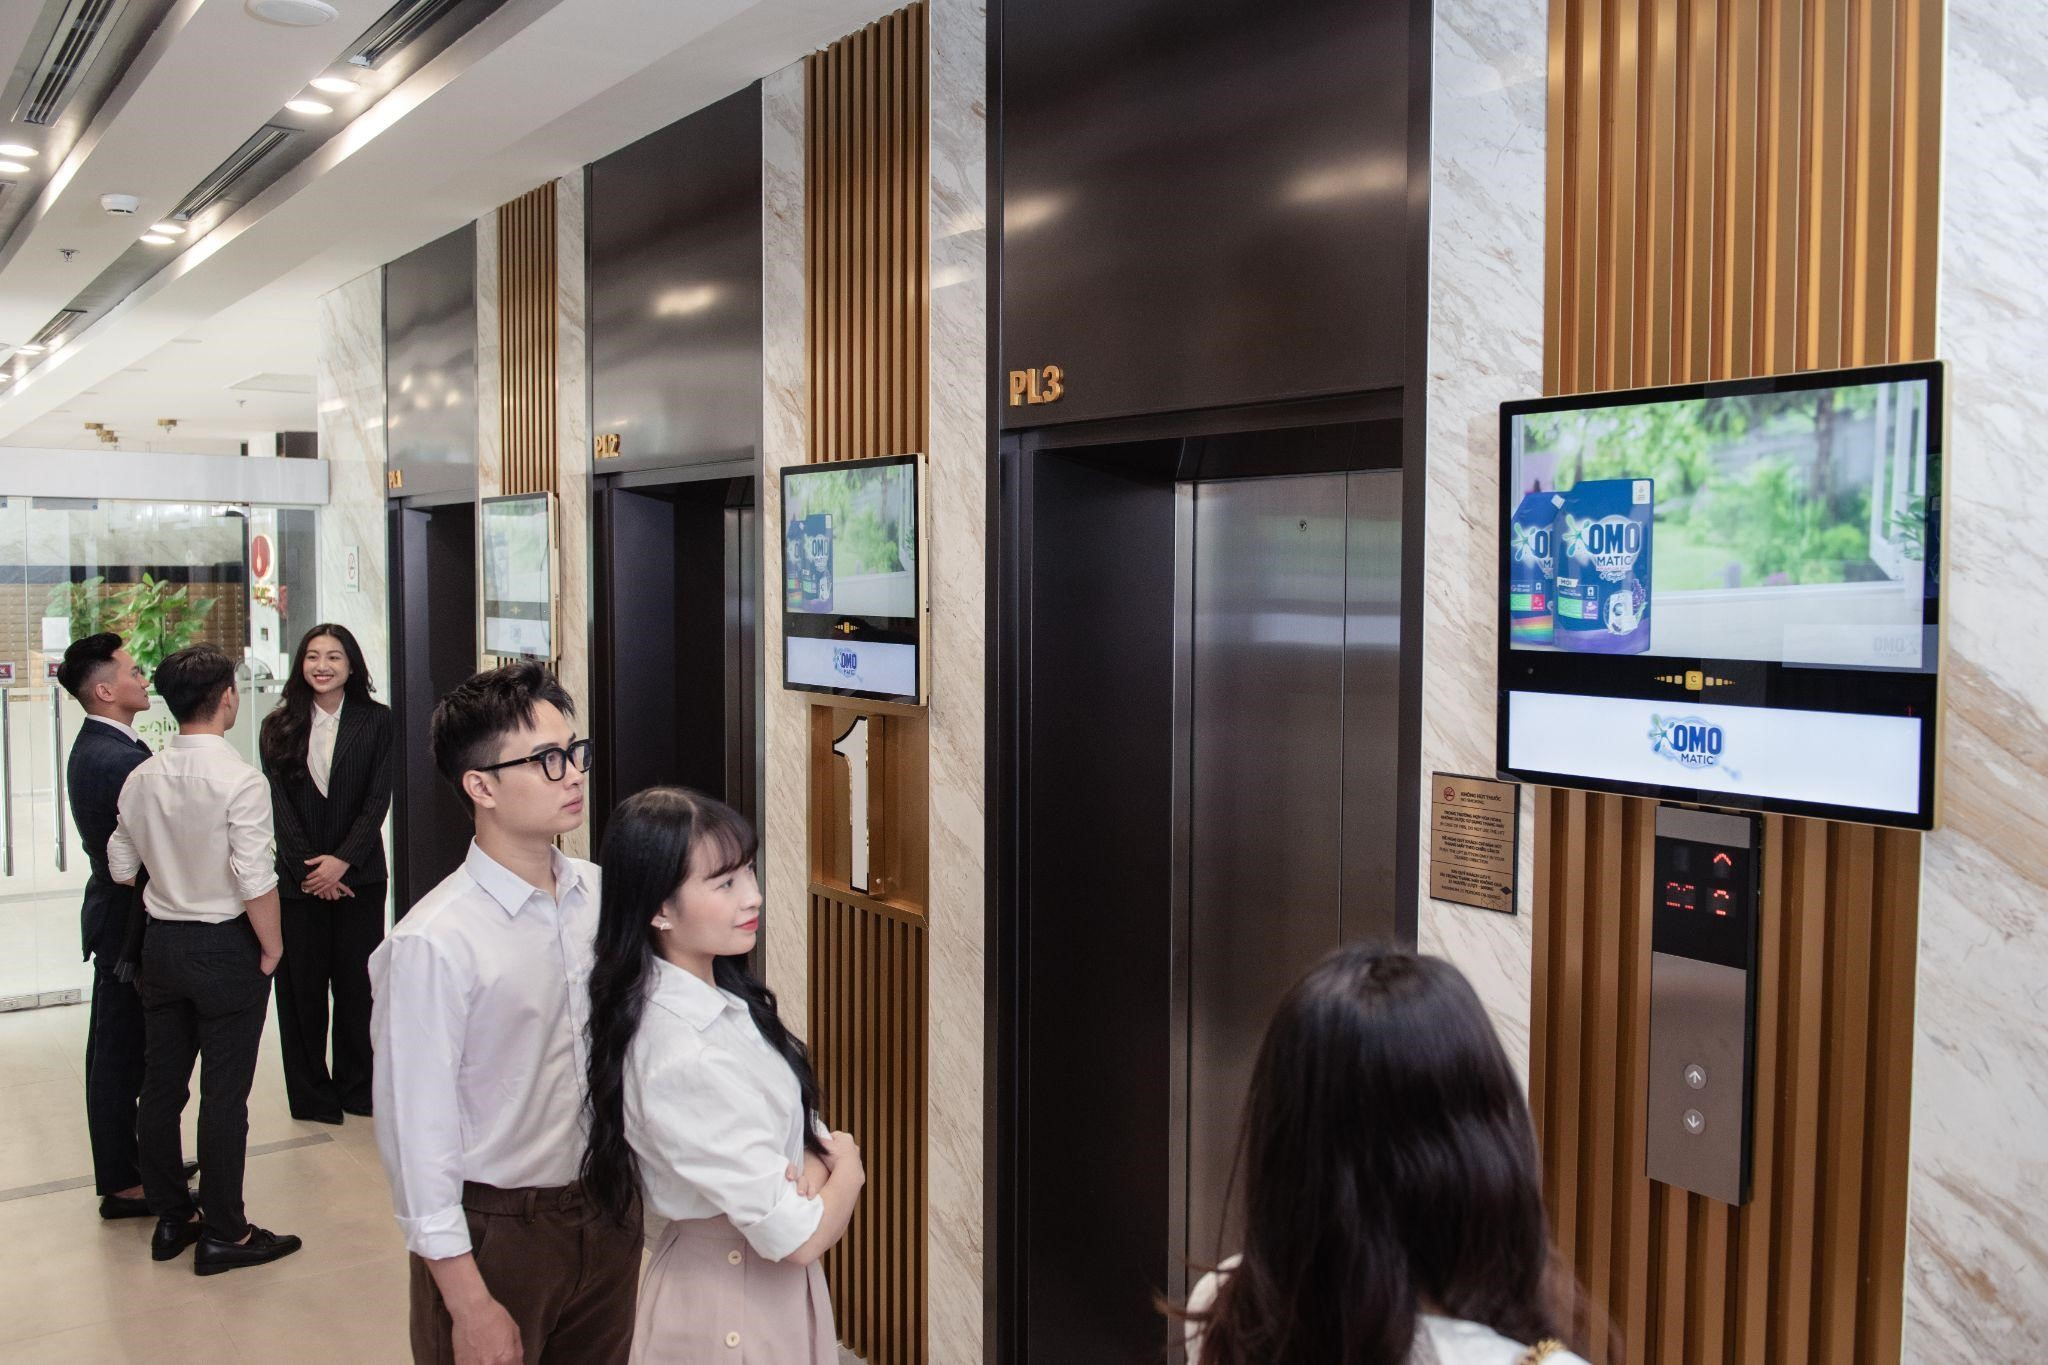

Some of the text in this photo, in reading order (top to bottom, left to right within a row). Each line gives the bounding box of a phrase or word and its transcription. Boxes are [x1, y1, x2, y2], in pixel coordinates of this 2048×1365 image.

[1009, 365, 1063, 406] PL3
[595, 434, 621, 458] PL2
[1589, 523, 1641, 554] OMO
[1597, 556, 1631, 566] MATIC
[841, 652, 857, 669] OMO
[1674, 724, 1722, 755] OMO
[1681, 753, 1713, 764] MATIC
[832, 716, 869, 894] 1
